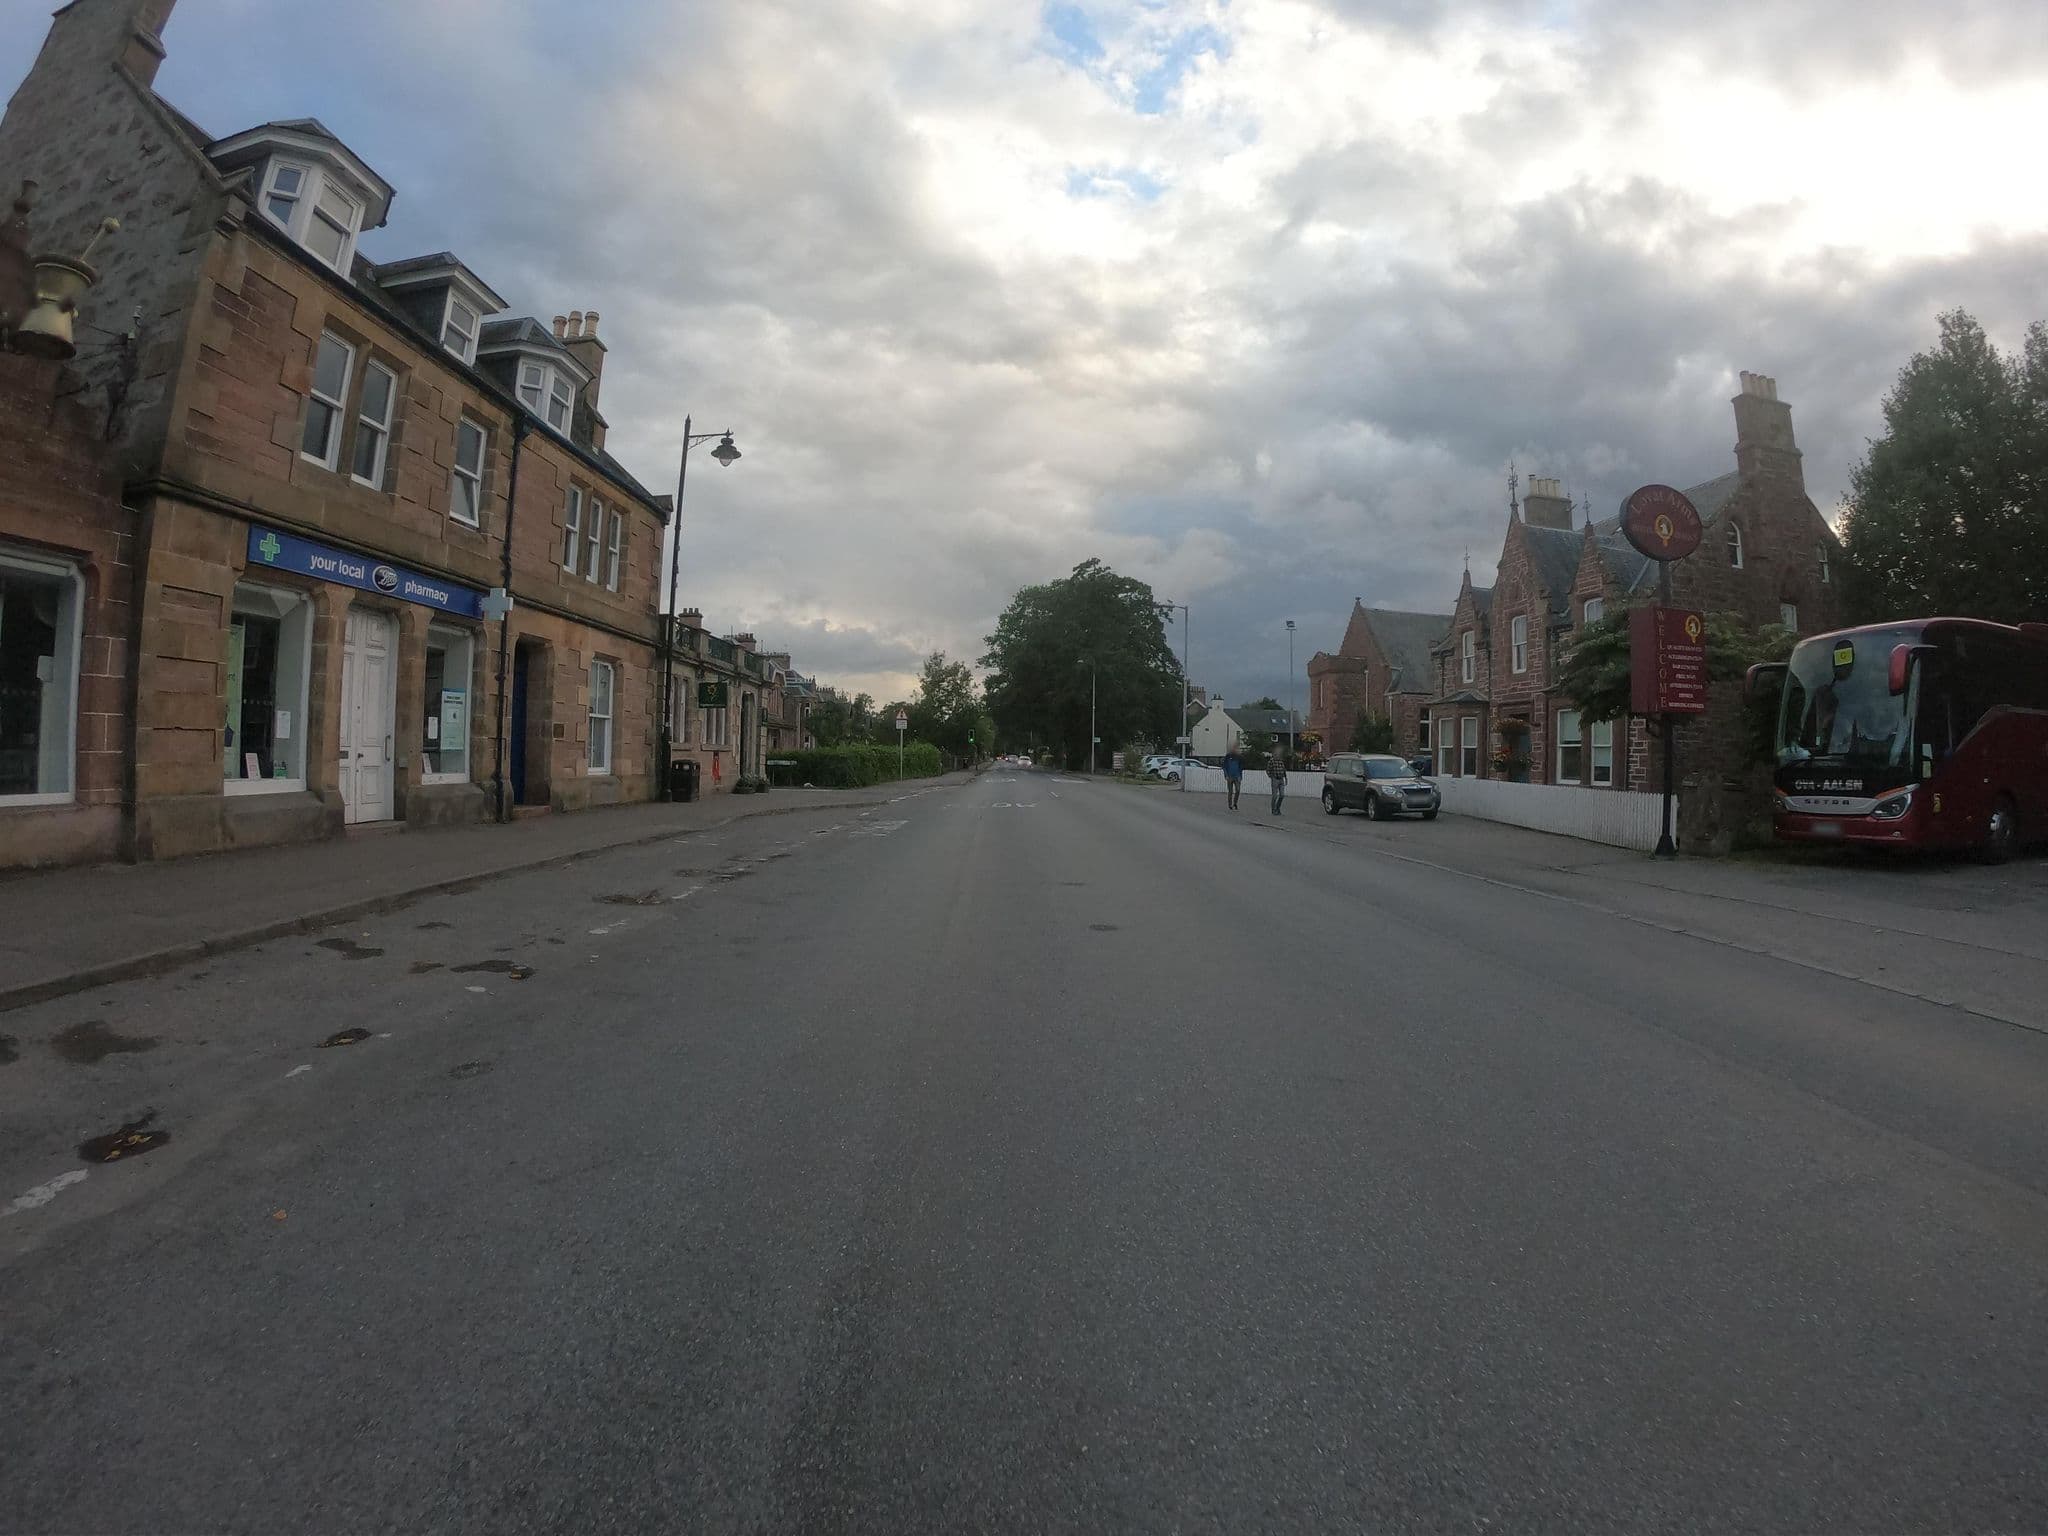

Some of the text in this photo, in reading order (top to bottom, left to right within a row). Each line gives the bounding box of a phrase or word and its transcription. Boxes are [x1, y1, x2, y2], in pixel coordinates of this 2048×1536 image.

[310, 555, 365, 579] your local
[405, 581, 449, 604] pharmacy
[1656, 610, 1667, 709] WELCOME
